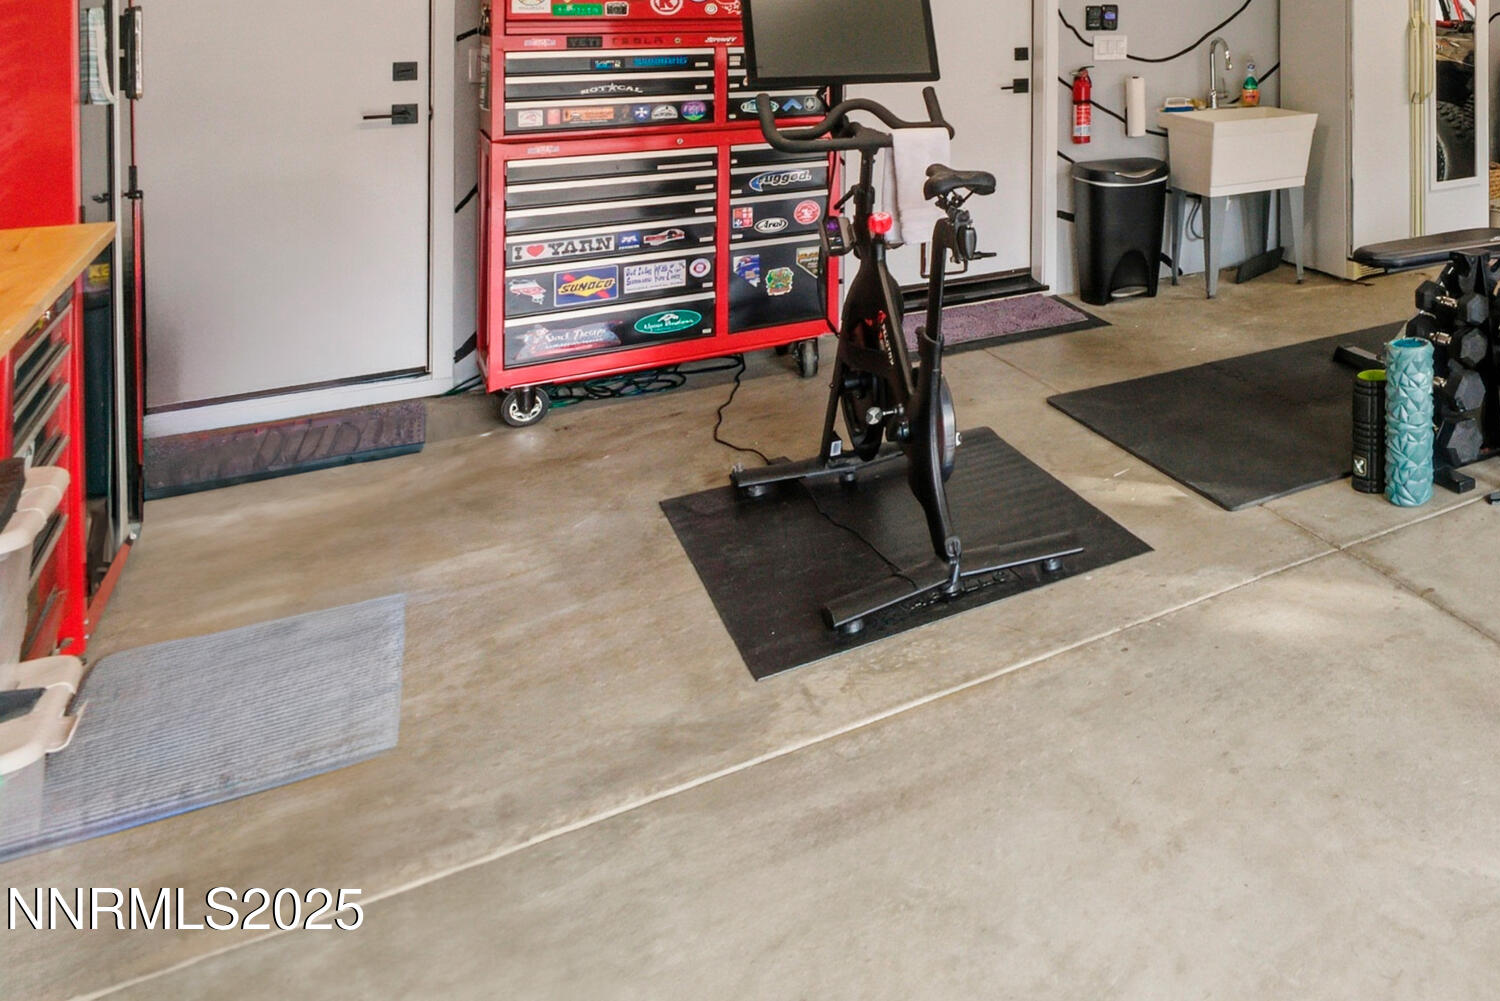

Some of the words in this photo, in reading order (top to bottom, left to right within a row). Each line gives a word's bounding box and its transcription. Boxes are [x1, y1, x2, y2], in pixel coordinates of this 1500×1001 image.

[514, 247, 523, 260] I
[549, 237, 613, 256] YARN
[560, 277, 615, 294] SUNOCO
